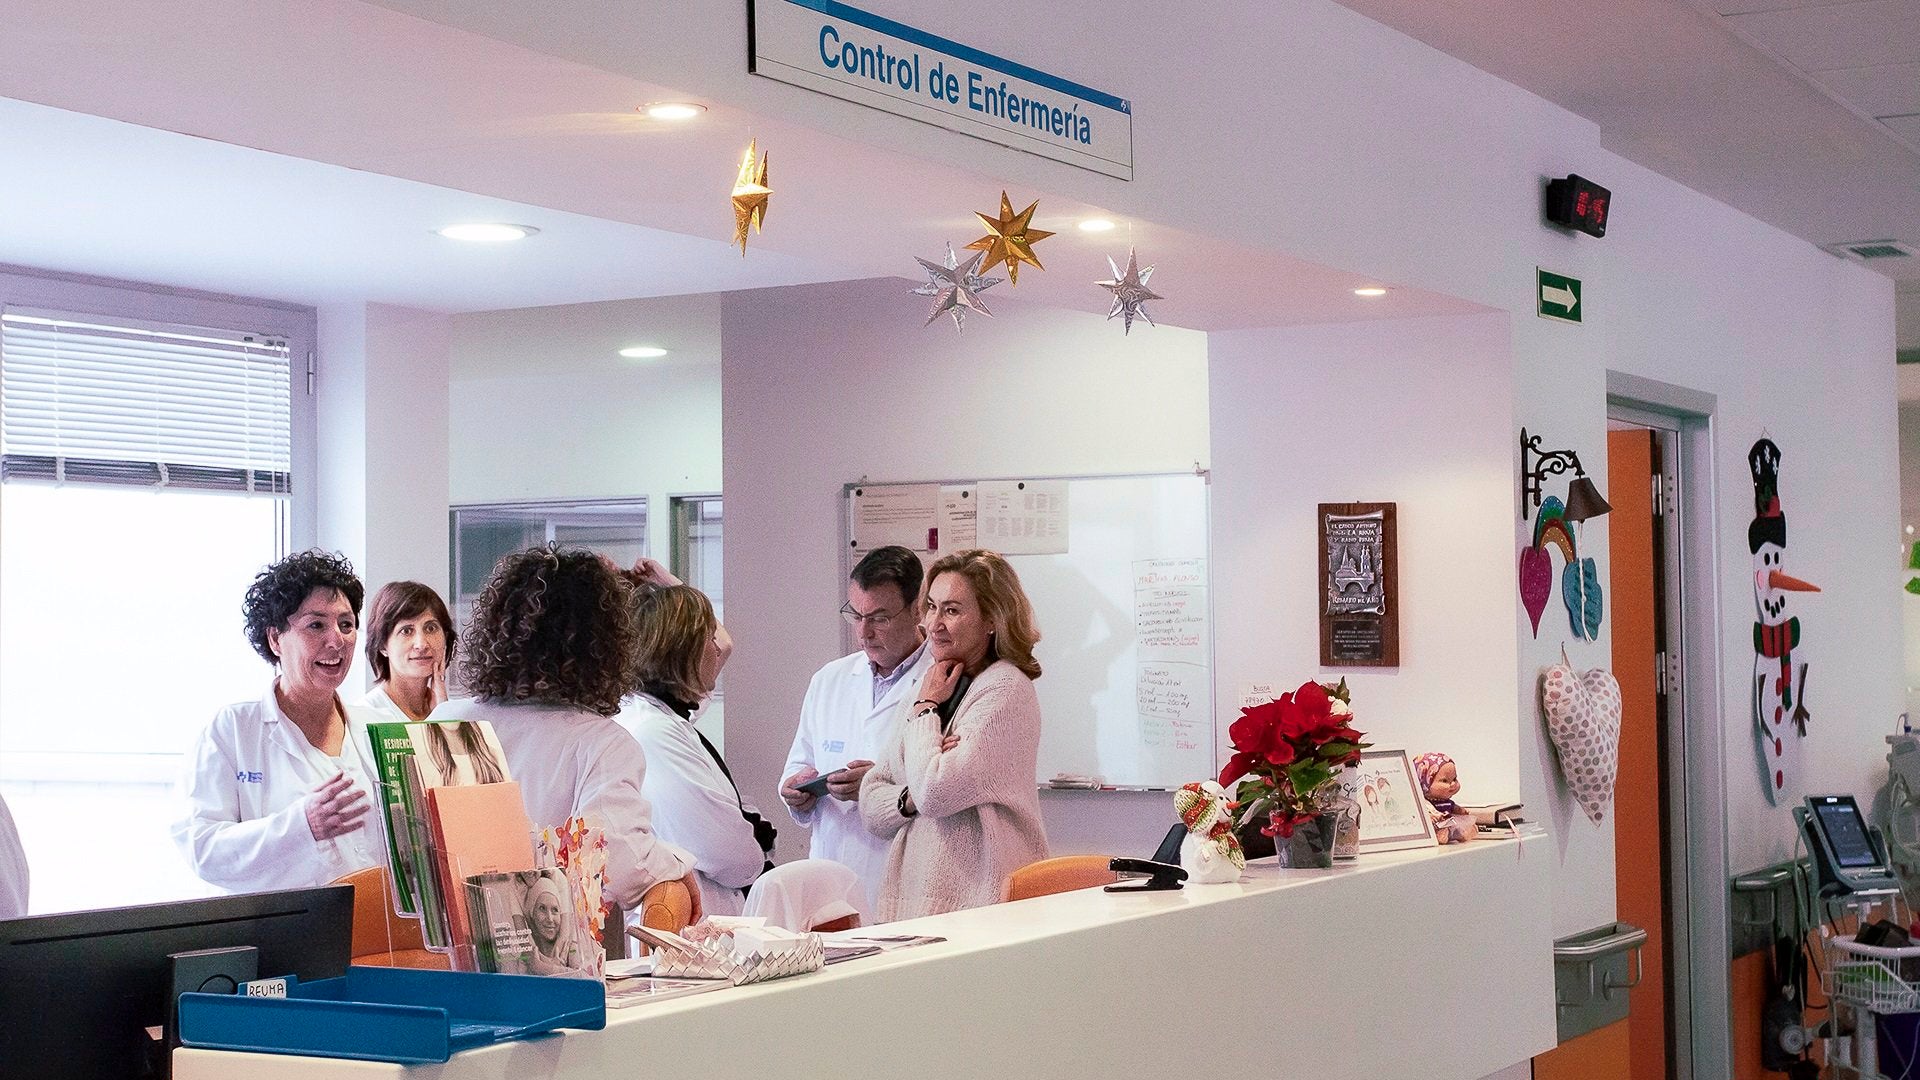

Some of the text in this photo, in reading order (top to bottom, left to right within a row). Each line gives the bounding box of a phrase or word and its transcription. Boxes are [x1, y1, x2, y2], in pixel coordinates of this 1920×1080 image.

[819, 25, 1092, 145] Control de Enfermería
[250, 983, 284, 997] REUMA
